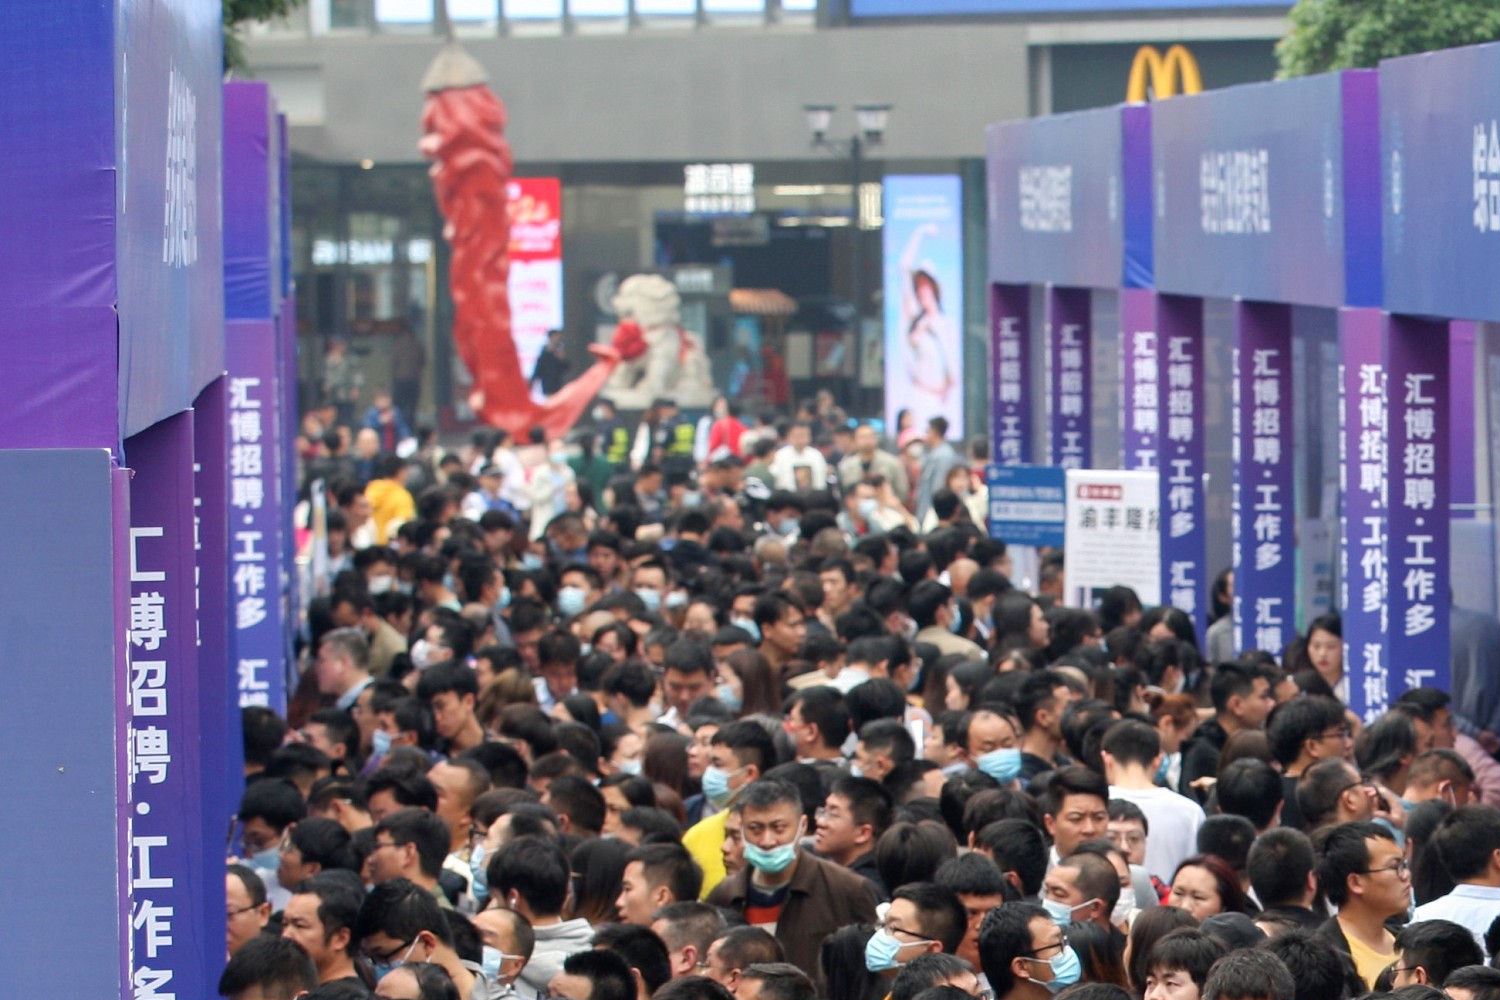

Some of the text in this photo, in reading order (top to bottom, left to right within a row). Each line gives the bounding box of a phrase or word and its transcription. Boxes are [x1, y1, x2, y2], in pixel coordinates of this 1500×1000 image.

[230, 377, 266, 630] 汇博招聘·工作多
[1000, 317, 1023, 466] 汇博招聘·工作
[1404, 373, 1436, 636] 汇博招聘·工作多
